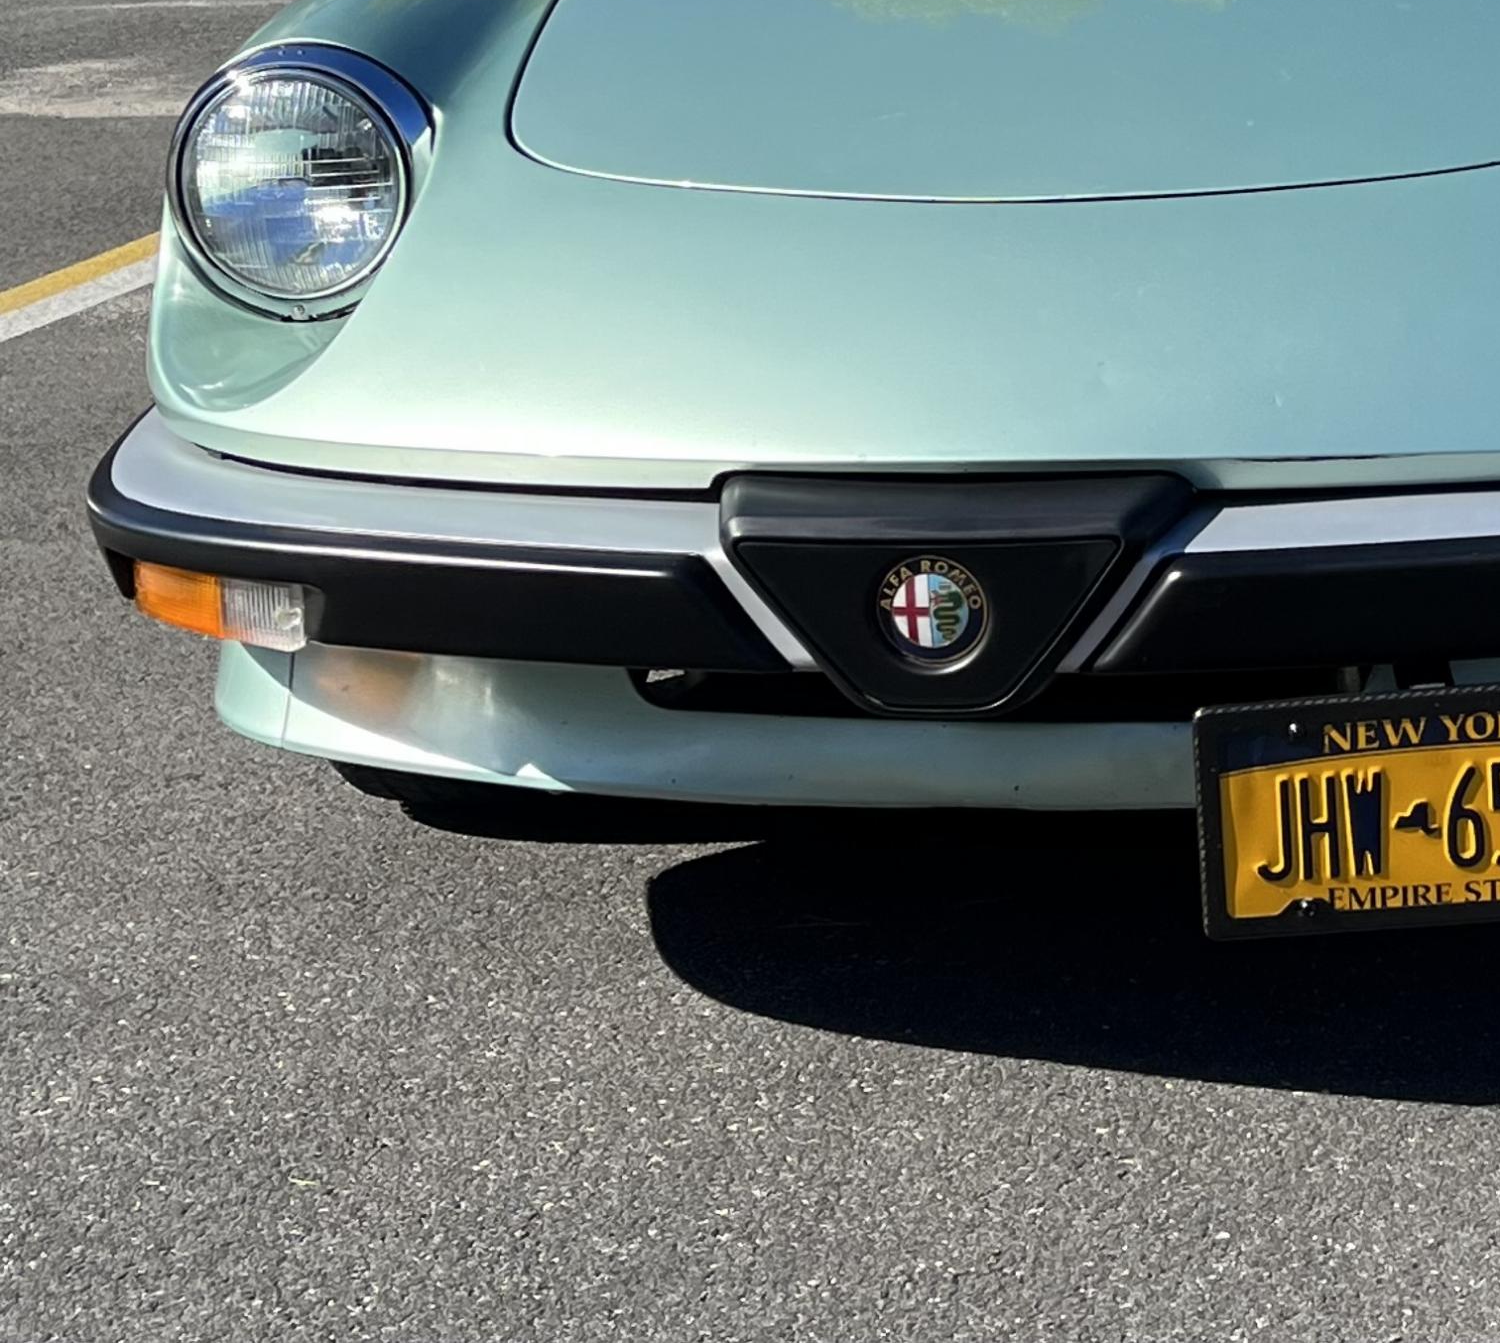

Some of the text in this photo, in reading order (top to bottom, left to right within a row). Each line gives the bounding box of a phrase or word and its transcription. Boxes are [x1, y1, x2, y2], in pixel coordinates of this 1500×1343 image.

[880, 559, 982, 611] ALFA ROMEO
[1323, 716, 1429, 753] NEW
[1327, 882, 1454, 910] EMPIRE
